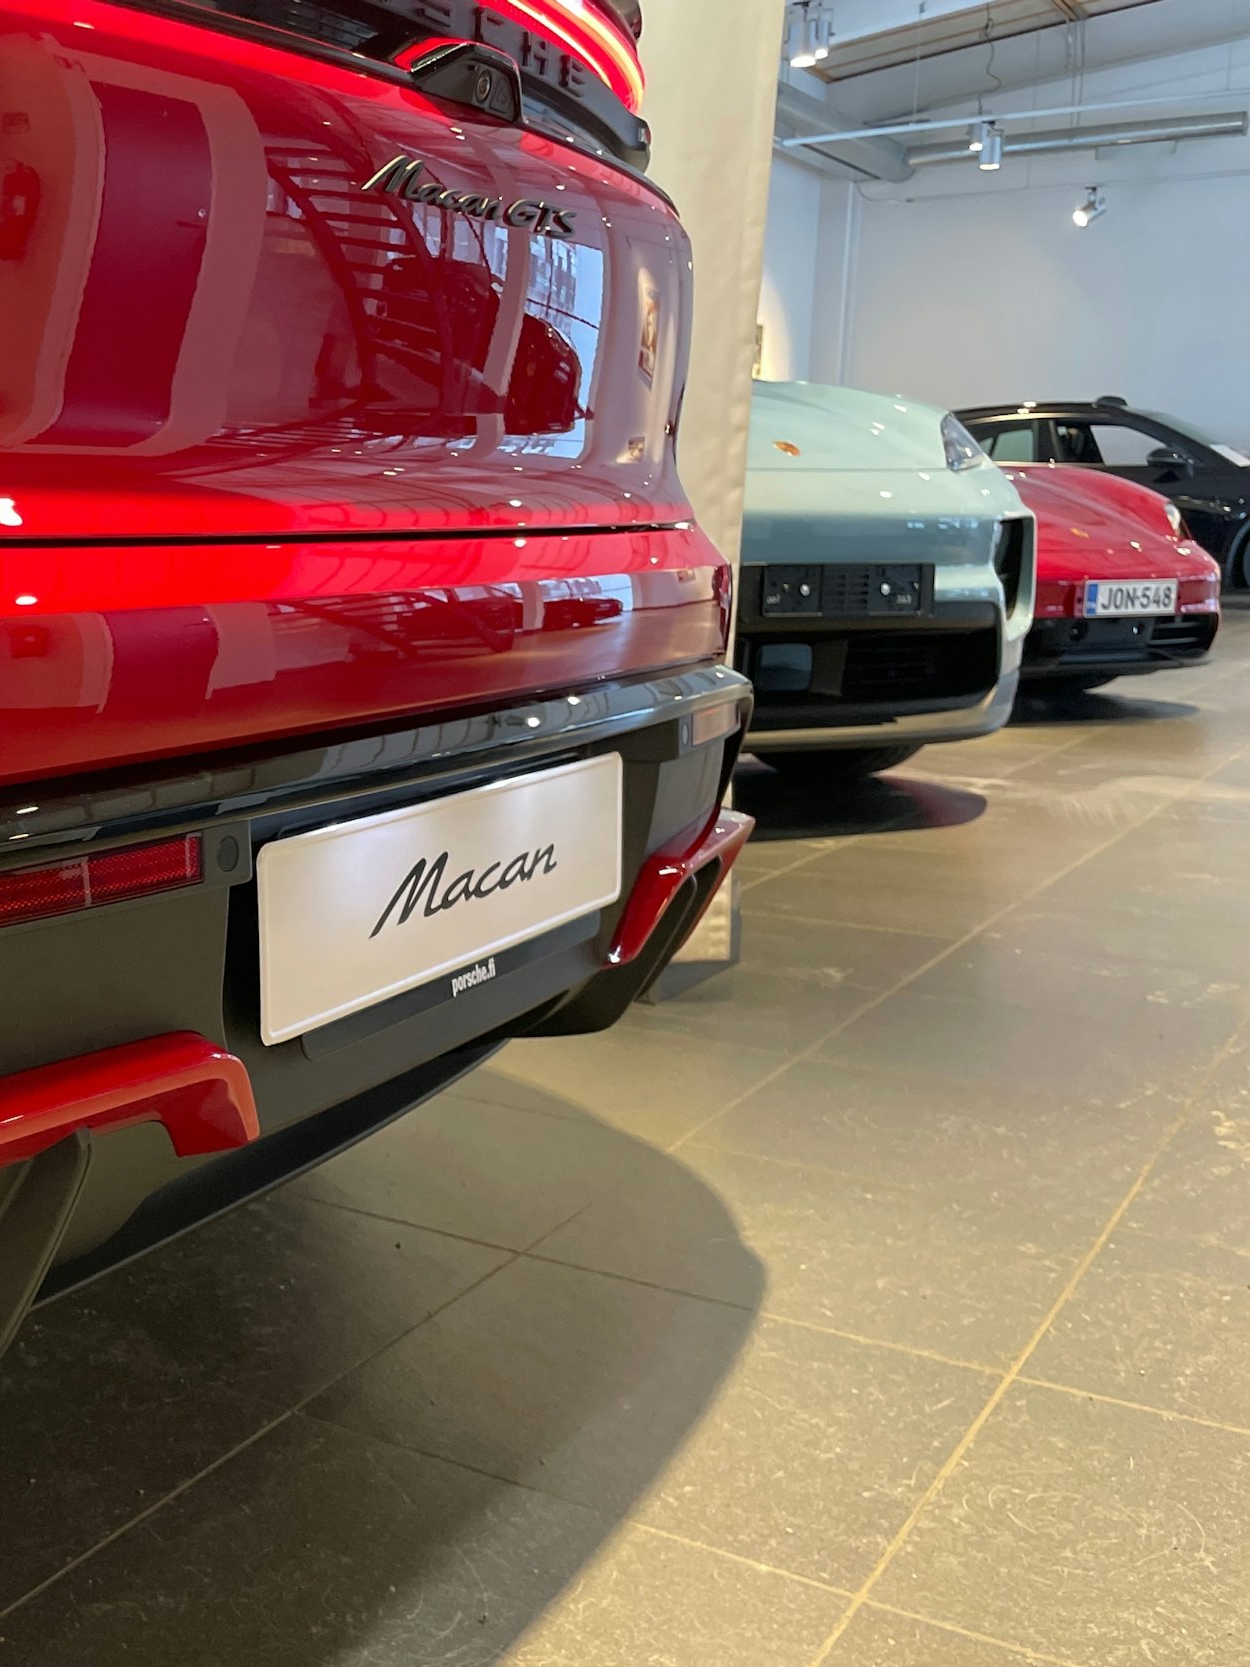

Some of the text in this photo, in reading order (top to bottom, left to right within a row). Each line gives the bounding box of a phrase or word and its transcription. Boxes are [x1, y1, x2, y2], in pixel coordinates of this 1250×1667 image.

[361, 155, 578, 239] Macan GTS
[1101, 585, 1173, 610] JON-548
[368, 843, 558, 939] Macan
[451, 956, 497, 998] porsche.fi
